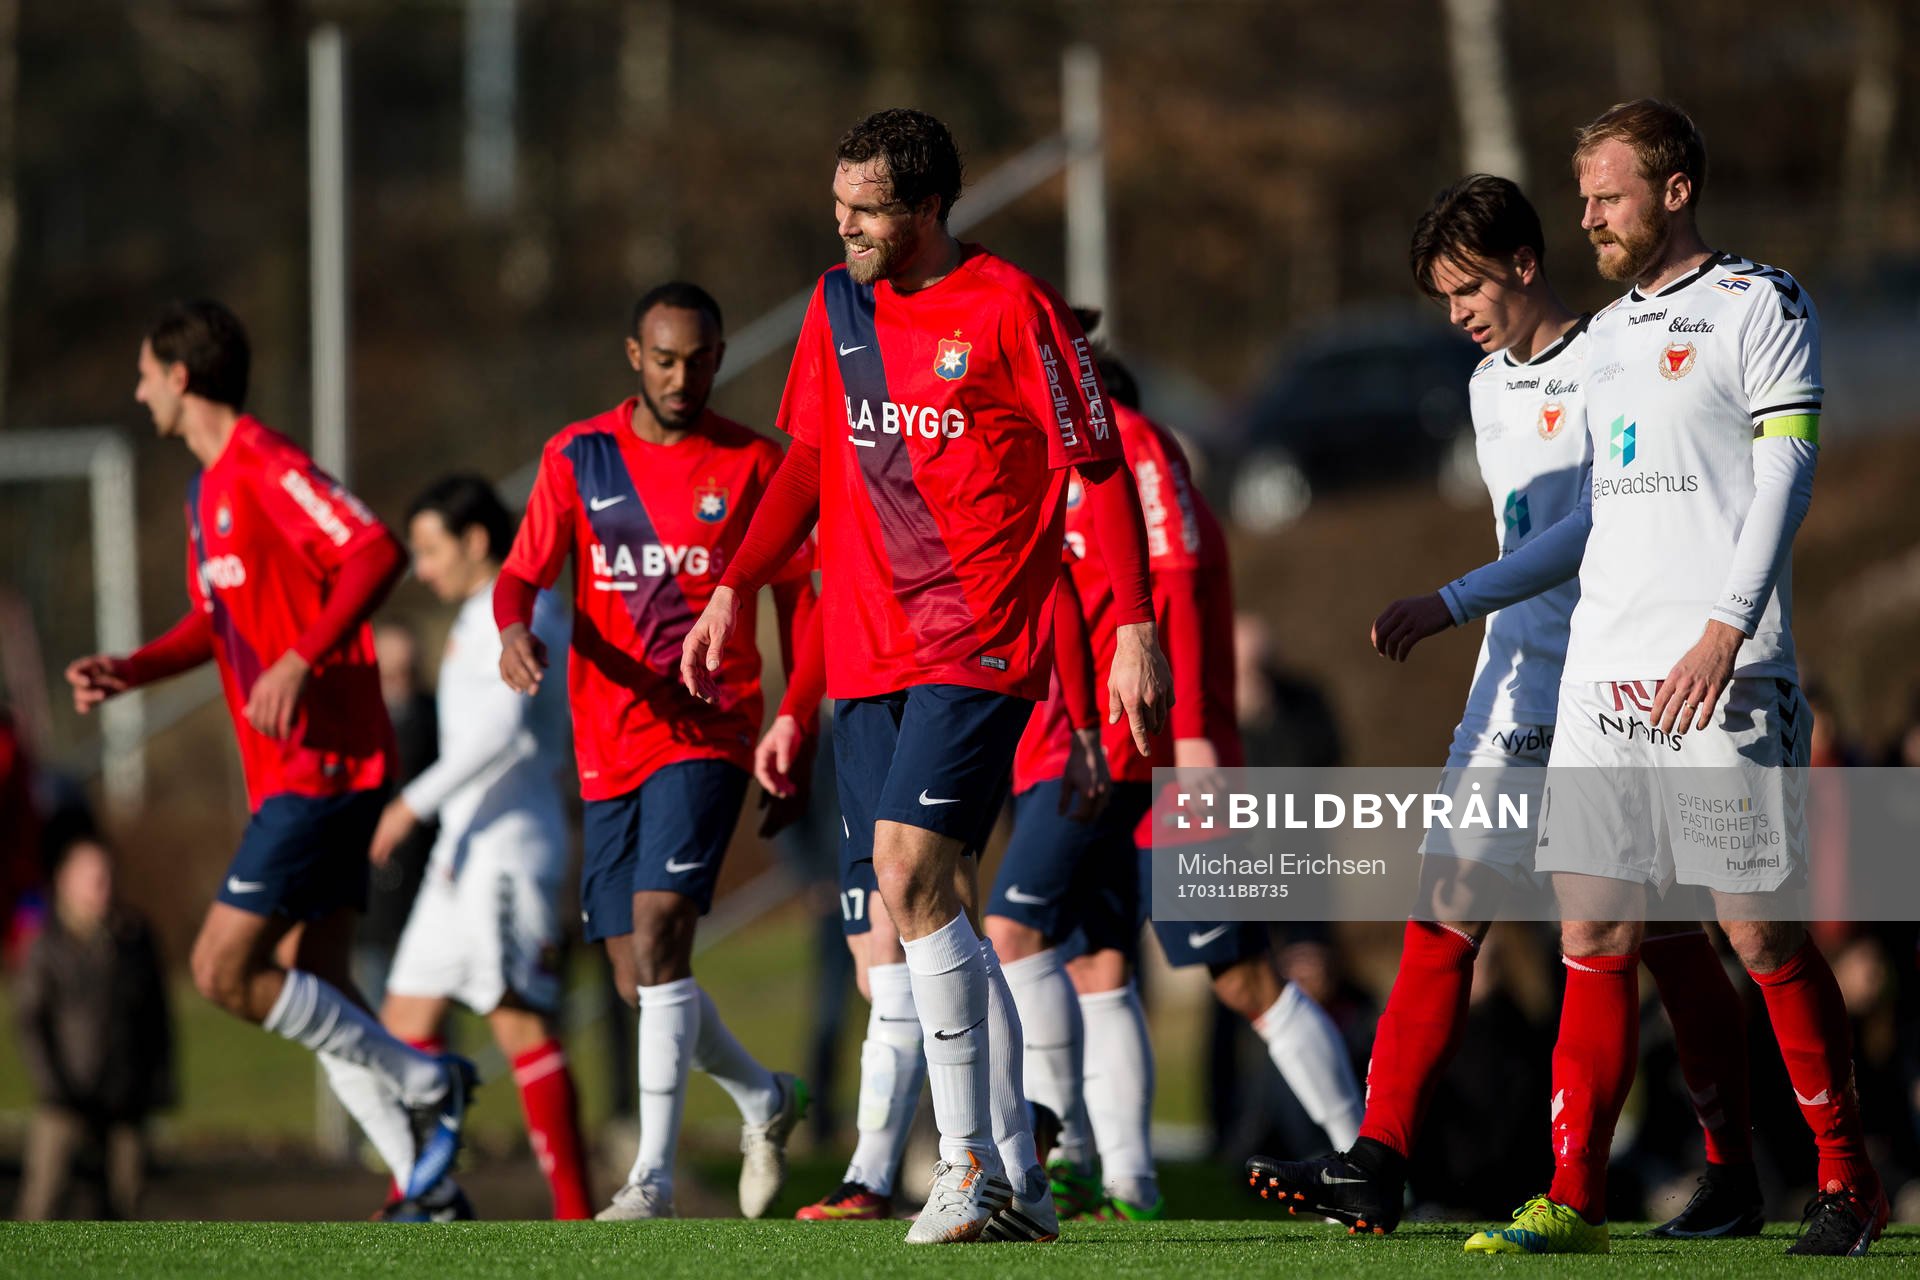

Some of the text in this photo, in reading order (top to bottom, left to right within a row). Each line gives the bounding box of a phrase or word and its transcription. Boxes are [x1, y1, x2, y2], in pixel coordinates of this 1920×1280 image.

[1627, 308, 1668, 327] hummel
[1668, 316, 1715, 333] Electra
[1072, 337, 1110, 441] stadium
[1505, 377, 1541, 391] hummel
[1039, 344, 1078, 447] stadium
[882, 401, 965, 439] BYGG
[642, 543, 725, 577] BYGG
[1677, 792, 1736, 814] SVENSK
[1680, 810, 1769, 832] FASTIGHETS
[1683, 827, 1780, 850] FÖRMEDLING
[1726, 855, 1780, 871] hummel
[840, 887, 865, 921] 17
